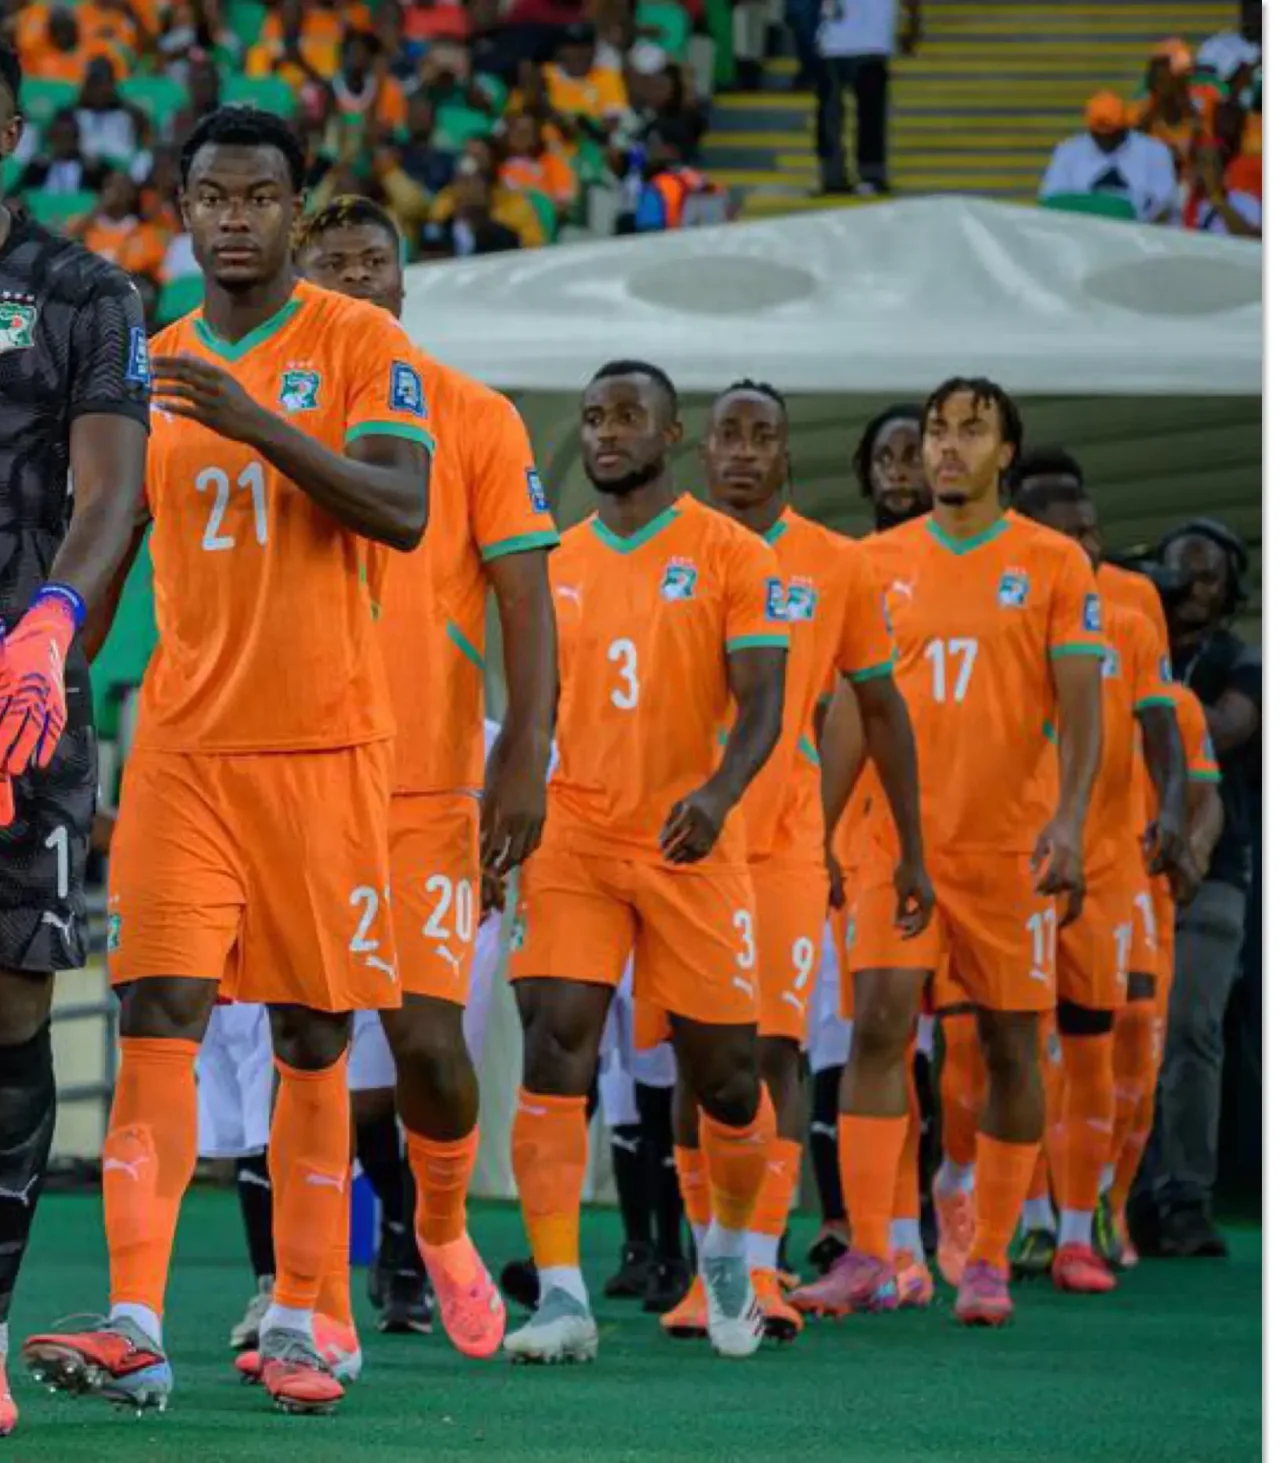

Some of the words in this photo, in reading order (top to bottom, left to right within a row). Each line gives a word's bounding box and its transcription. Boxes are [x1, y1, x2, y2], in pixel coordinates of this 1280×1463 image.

[195, 462, 268, 551] 21
[607, 637, 639, 709] 3
[924, 637, 978, 703] 17
[45, 825, 69, 899] 1
[349, 885, 390, 951] 2
[423, 874, 473, 942] 20
[733, 908, 756, 969] 3
[792, 937, 813, 989] 9
